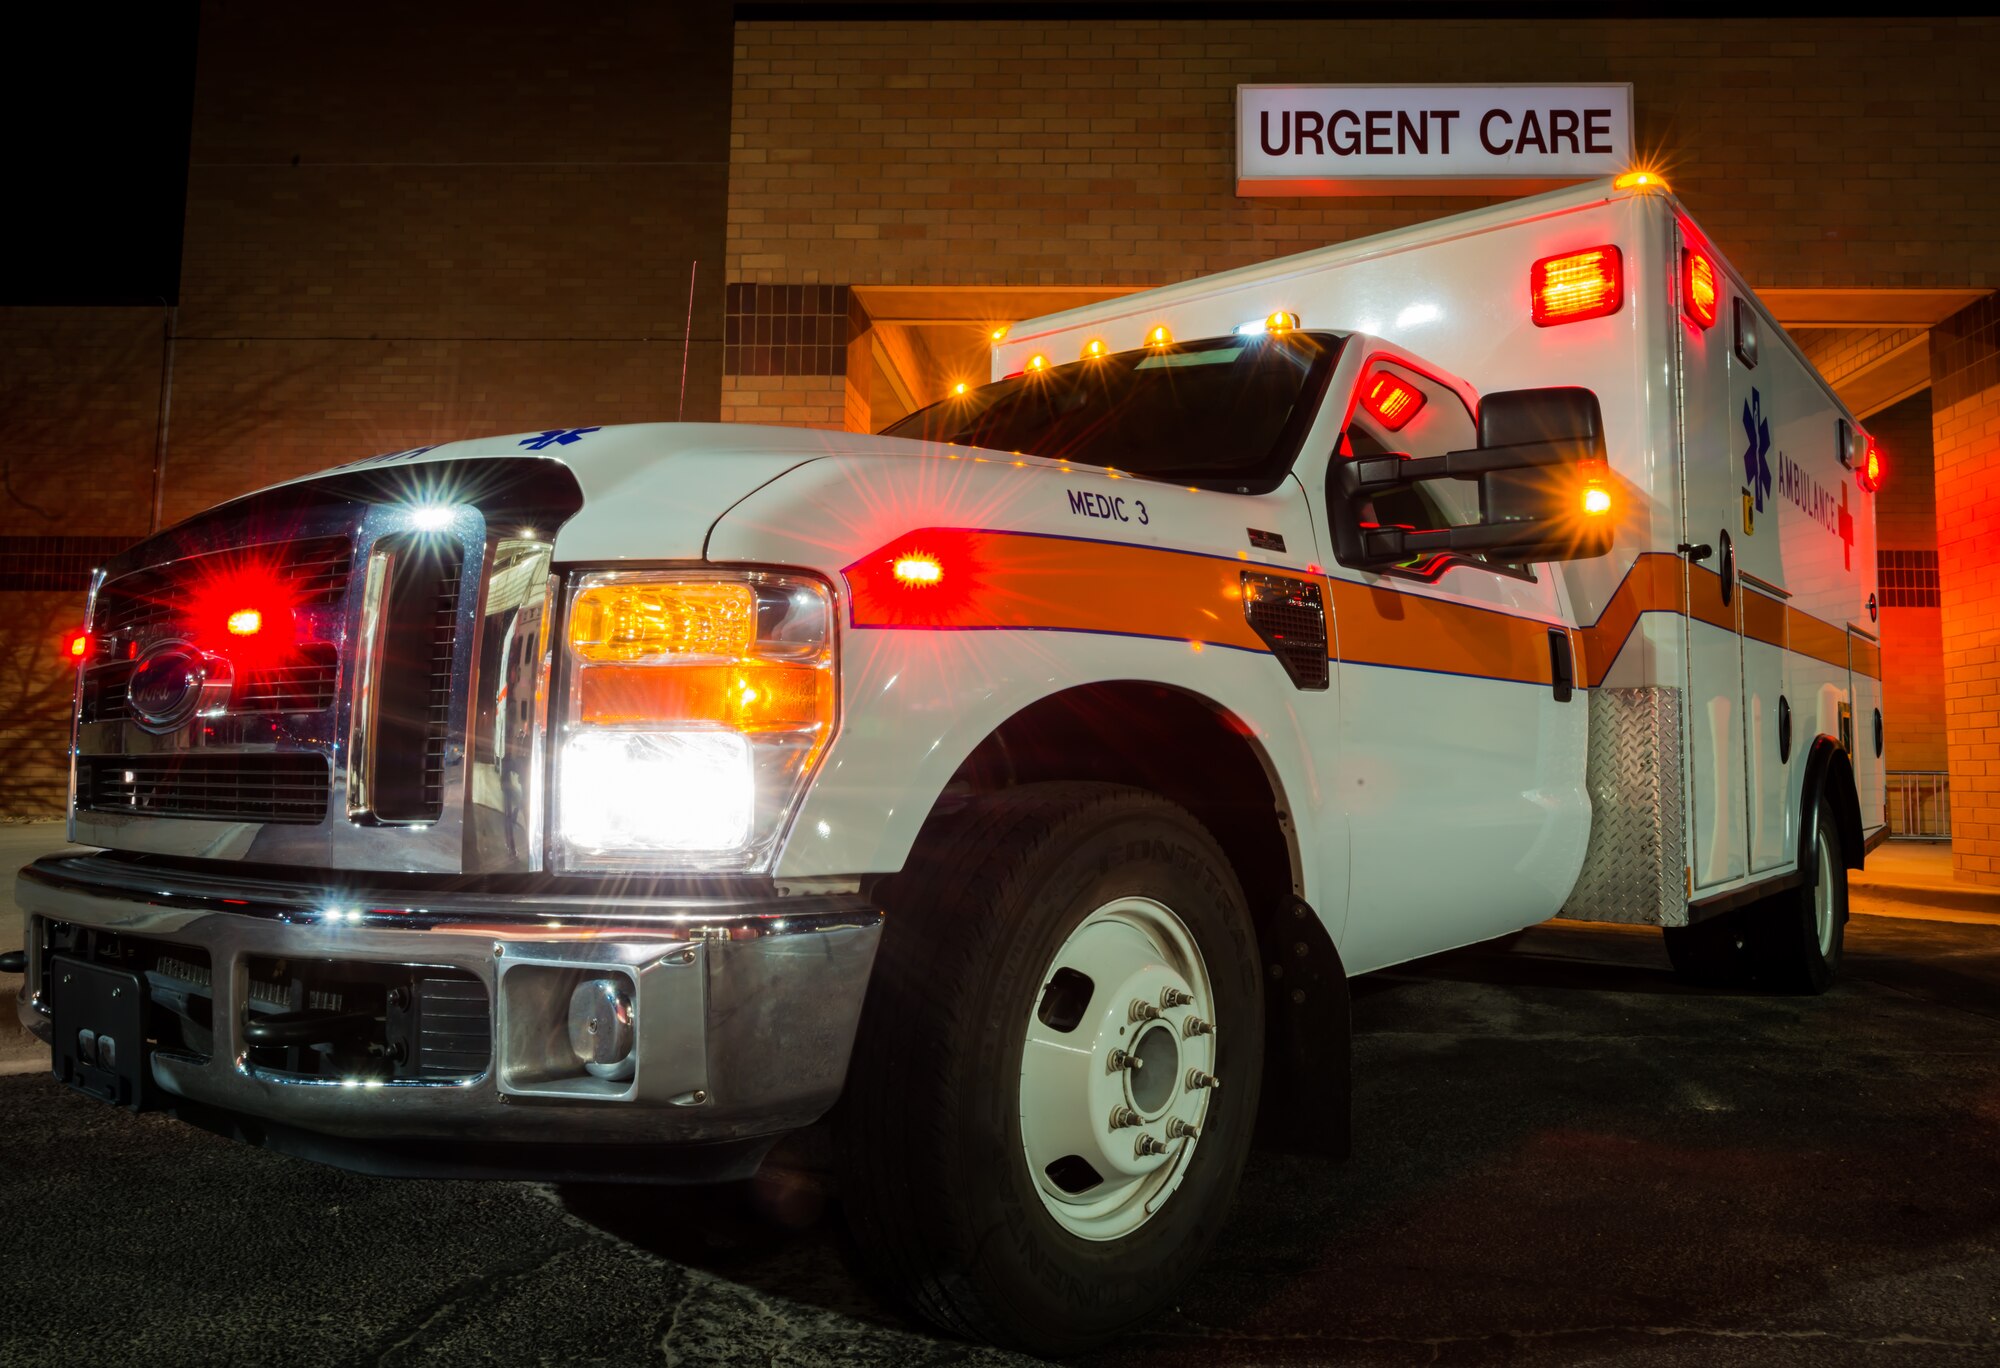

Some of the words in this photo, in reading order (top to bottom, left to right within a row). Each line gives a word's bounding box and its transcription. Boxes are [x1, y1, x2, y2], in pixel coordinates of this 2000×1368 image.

[1260, 109, 1460, 156] URGENT
[1479, 109, 1613, 156] CARE
[1067, 489, 1129, 522] MEDIC
[1135, 500, 1149, 525] 3
[1778, 450, 1836, 535] AMBULANCE
